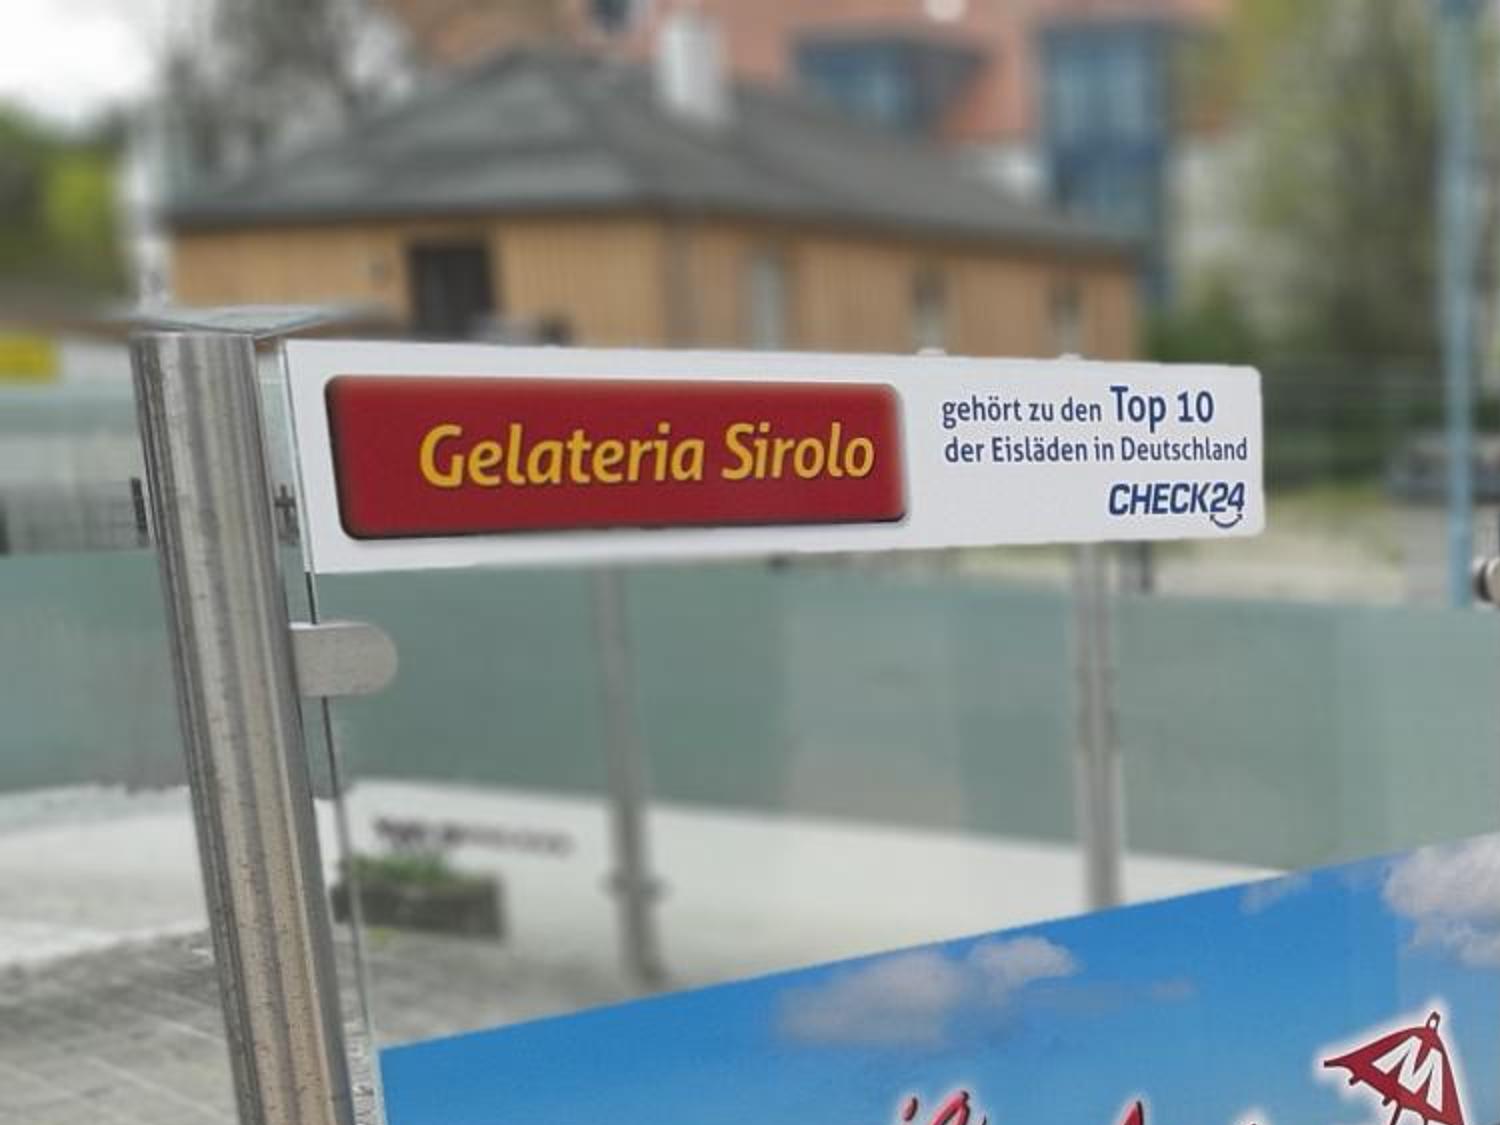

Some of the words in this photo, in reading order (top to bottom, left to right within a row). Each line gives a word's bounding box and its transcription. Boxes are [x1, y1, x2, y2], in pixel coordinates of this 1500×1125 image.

[942, 395, 1022, 429] gehört
[1029, 402, 1054, 422] zu
[1061, 397, 1101, 422] den
[1110, 385, 1166, 433] Top
[1177, 391, 1214, 423] 10
[420, 421, 703, 489] Gelateria
[722, 423, 875, 483] Sirolo
[945, 437, 984, 463] der
[992, 436, 1087, 463] Eisläden
[1095, 437, 1115, 461] in
[1121, 436, 1248, 461] Deutschland
[1109, 482, 1246, 517] CHECK24
